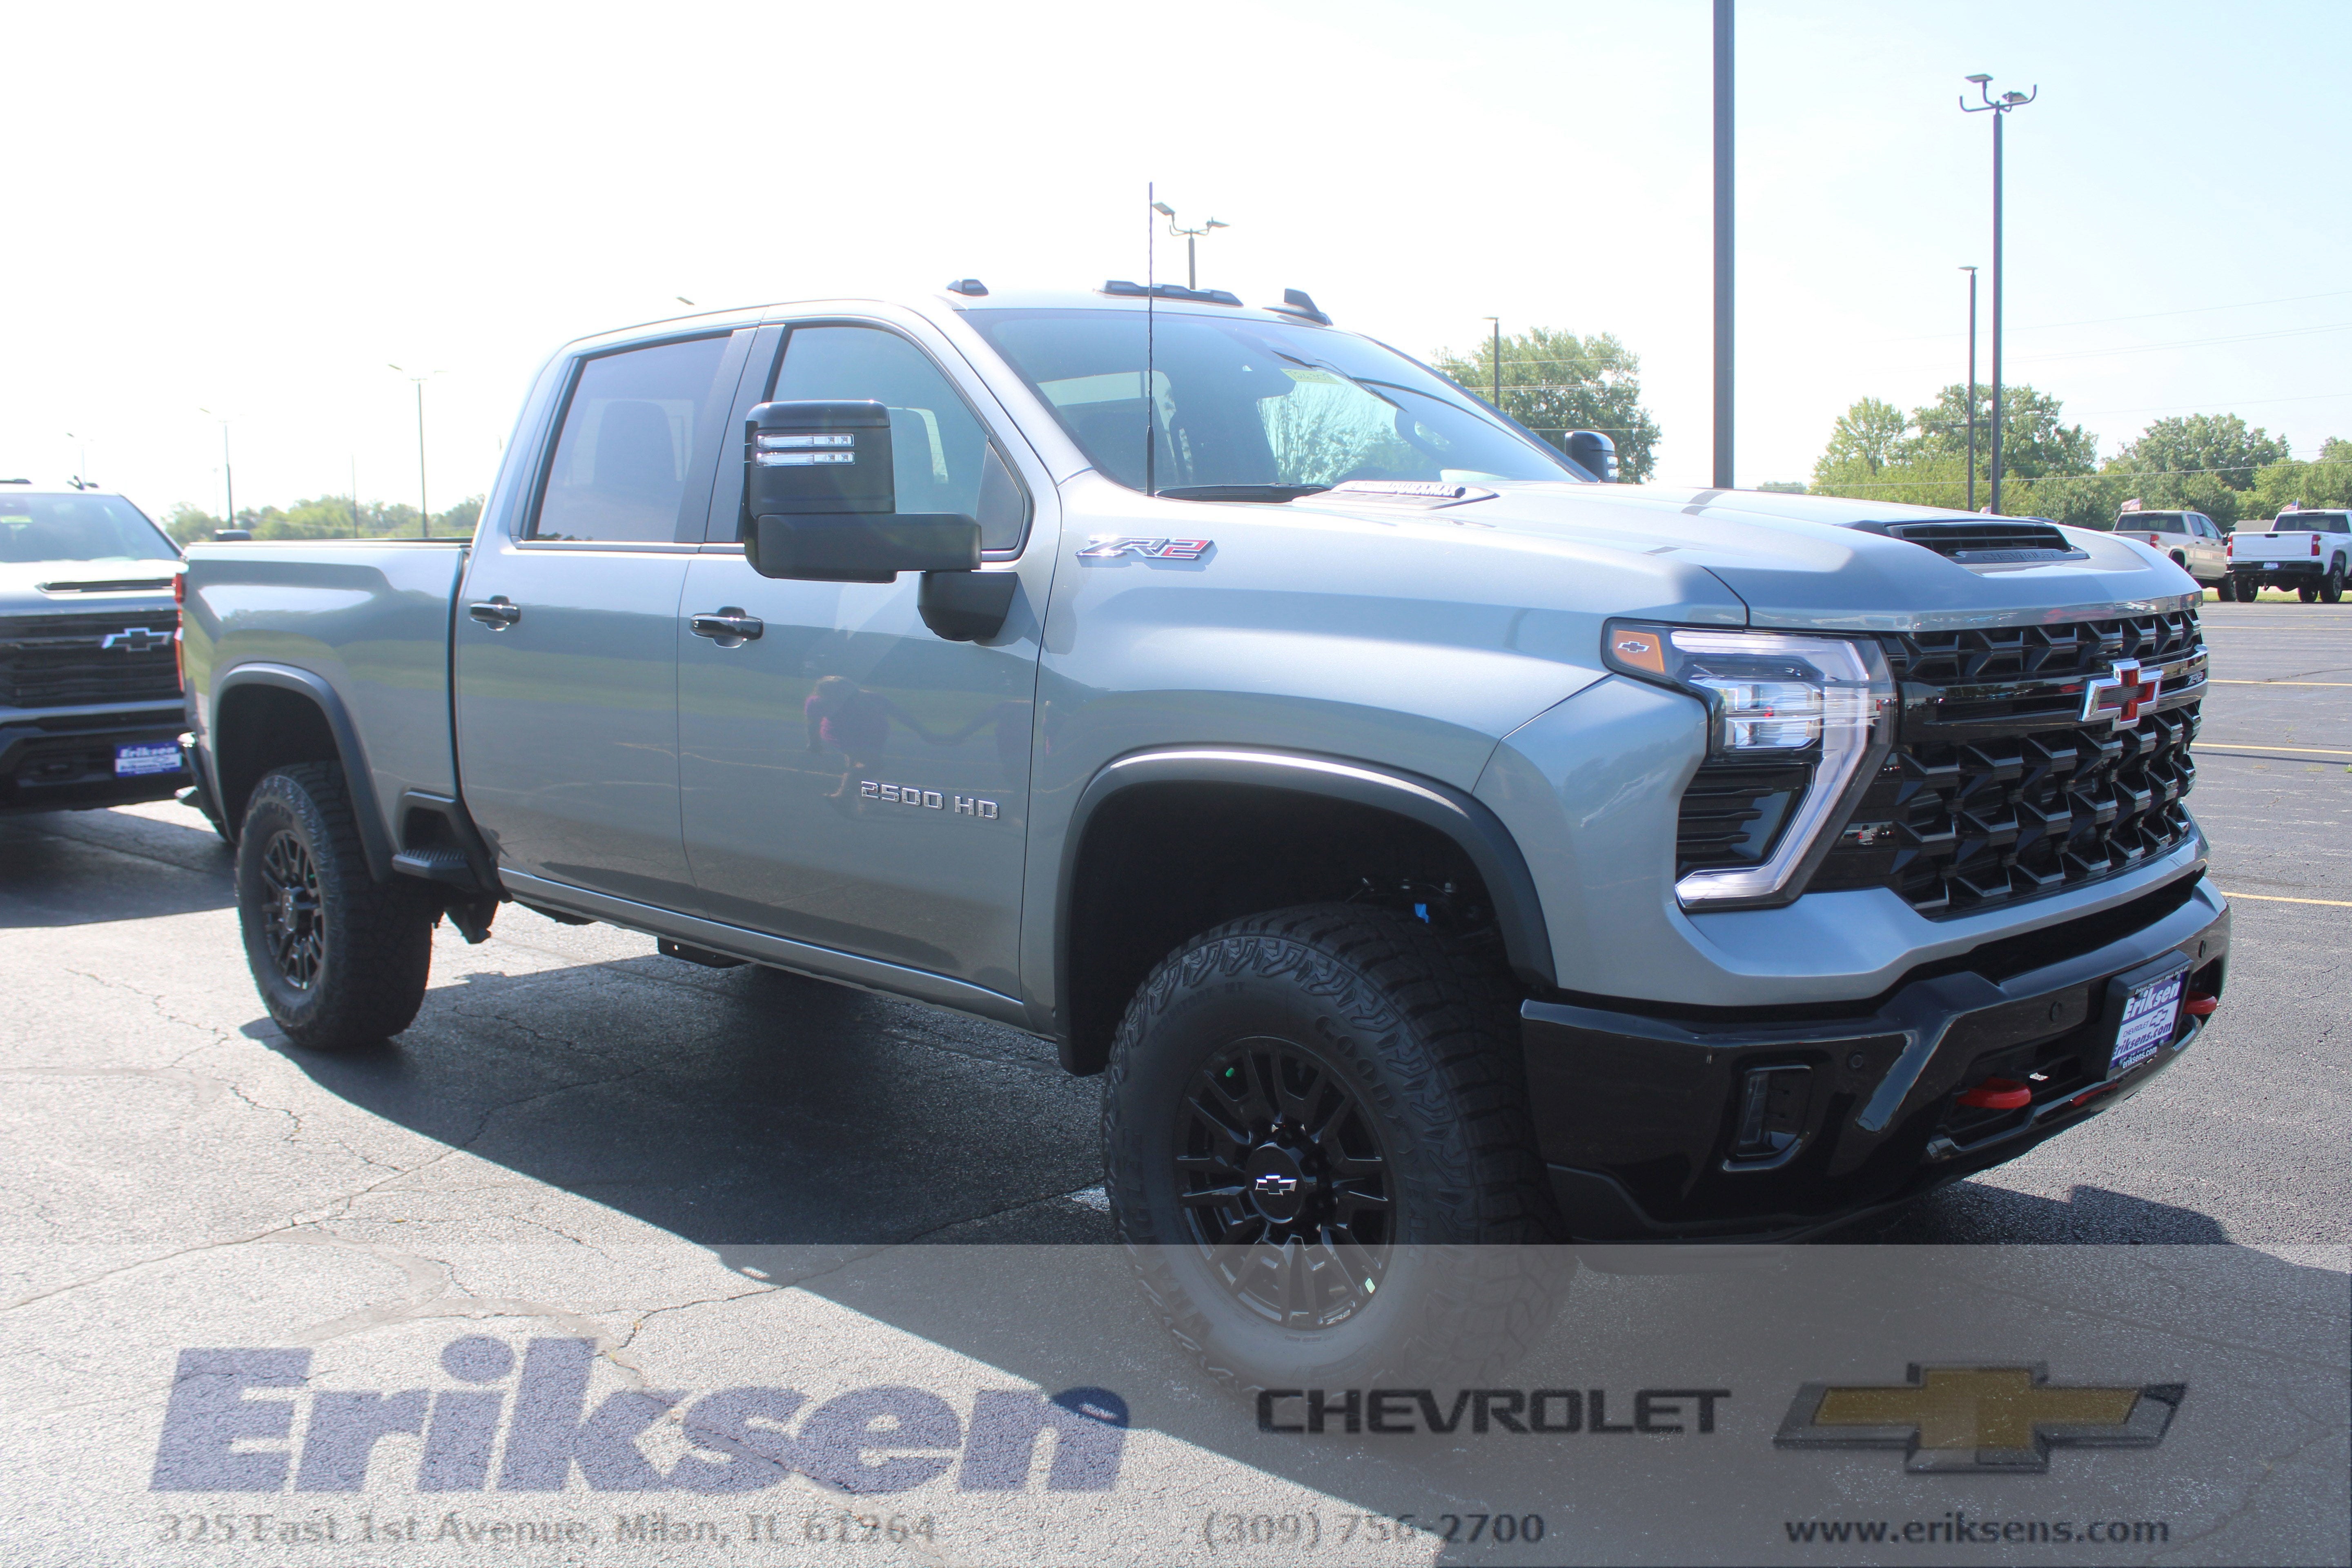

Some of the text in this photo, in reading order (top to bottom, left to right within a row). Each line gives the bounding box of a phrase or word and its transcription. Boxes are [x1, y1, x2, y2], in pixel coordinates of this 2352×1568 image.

[1389, 482, 1461, 497] DURAMAX
[1075, 535, 1215, 561] ZR2
[1982, 552, 2055, 561] CHEVROLET
[2187, 672, 2203, 686] ZR2
[861, 780, 999, 820] 2500 HD
[2123, 981, 2180, 1022] Eriksen
[2123, 1021, 2149, 1038] CHEVROLET
[2122, 1046, 2157, 1069] eriksens.com
